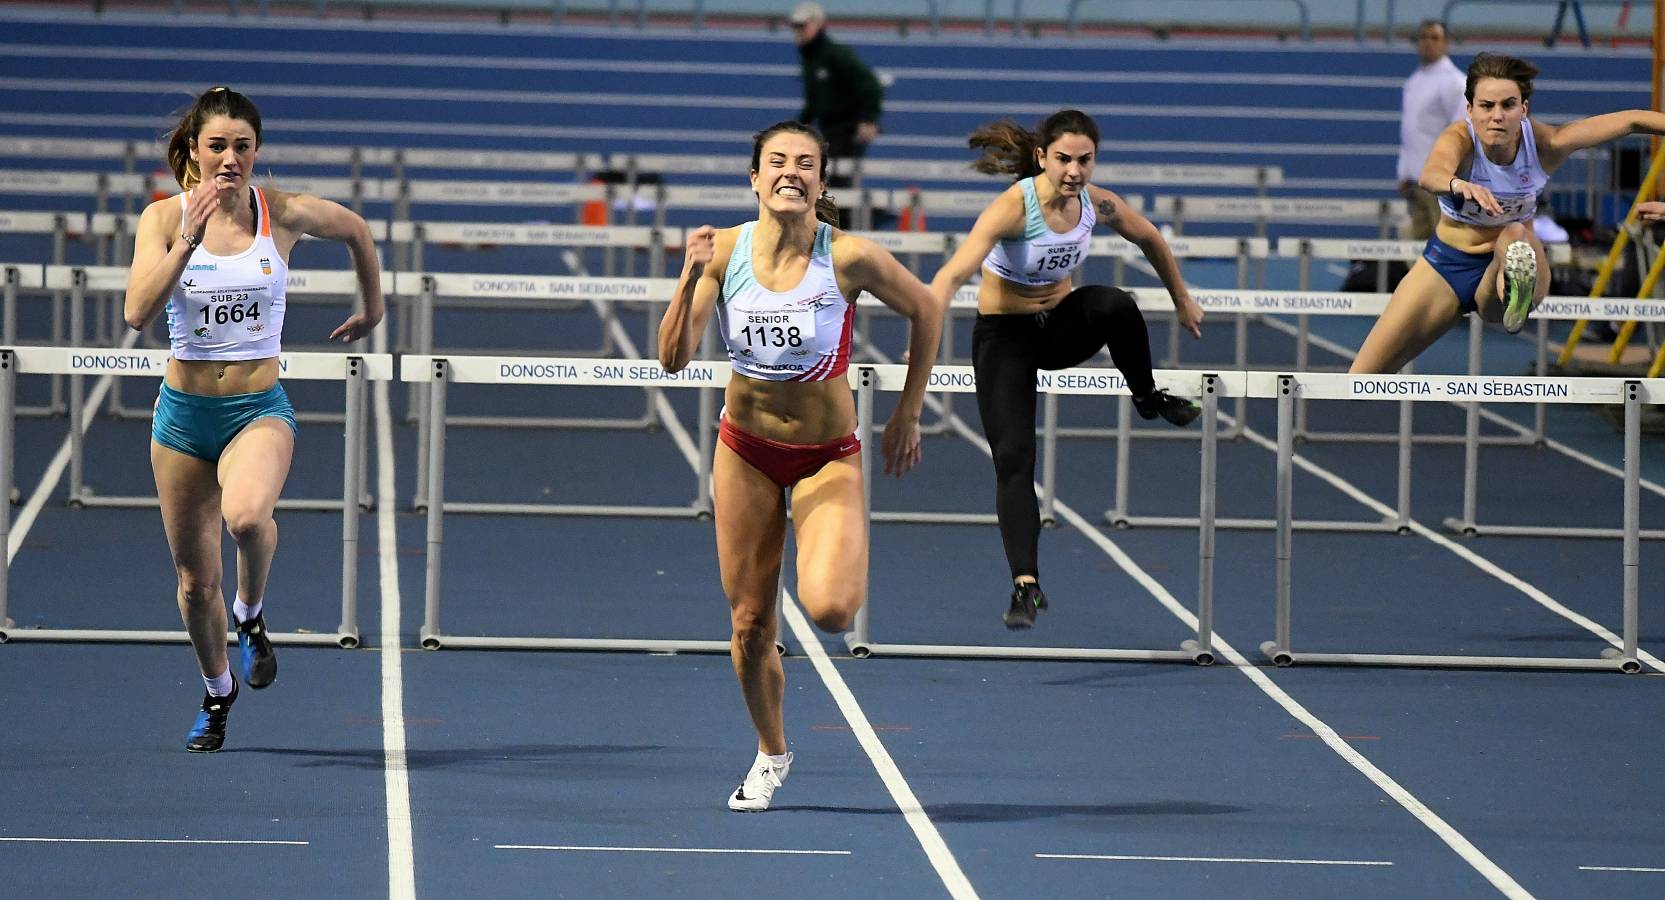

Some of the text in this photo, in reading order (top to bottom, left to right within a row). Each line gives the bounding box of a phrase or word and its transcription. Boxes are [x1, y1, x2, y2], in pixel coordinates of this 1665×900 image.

[1037, 250, 1081, 271] 1581
[549, 282, 575, 295] SAN
[578, 283, 647, 296] SEBASTIAN
[211, 293, 249, 303] SUB-23
[1194, 295, 1242, 306] NOSTIA
[1254, 296, 1279, 308] SAN
[1284, 297, 1352, 310] SEBASTIAN
[200, 302, 260, 324] 1664
[1535, 302, 1591, 315] ONOSTIA
[1604, 304, 1630, 316] SAN
[748, 315, 790, 324] SENIOR
[741, 325, 803, 347] 1138
[72, 355, 150, 370] DONOSTIA
[500, 364, 578, 379] DONOSTIA
[593, 366, 623, 379] SAN
[629, 366, 713, 381] SEBASTIAN
[928, 373, 977, 387] DONO
[1057, 374, 1129, 389] SEBASTIA
[1353, 381, 1432, 395] DONOSTIA
[1447, 382, 1478, 396] SAN
[1483, 382, 1568, 397] SEBASTIAN
